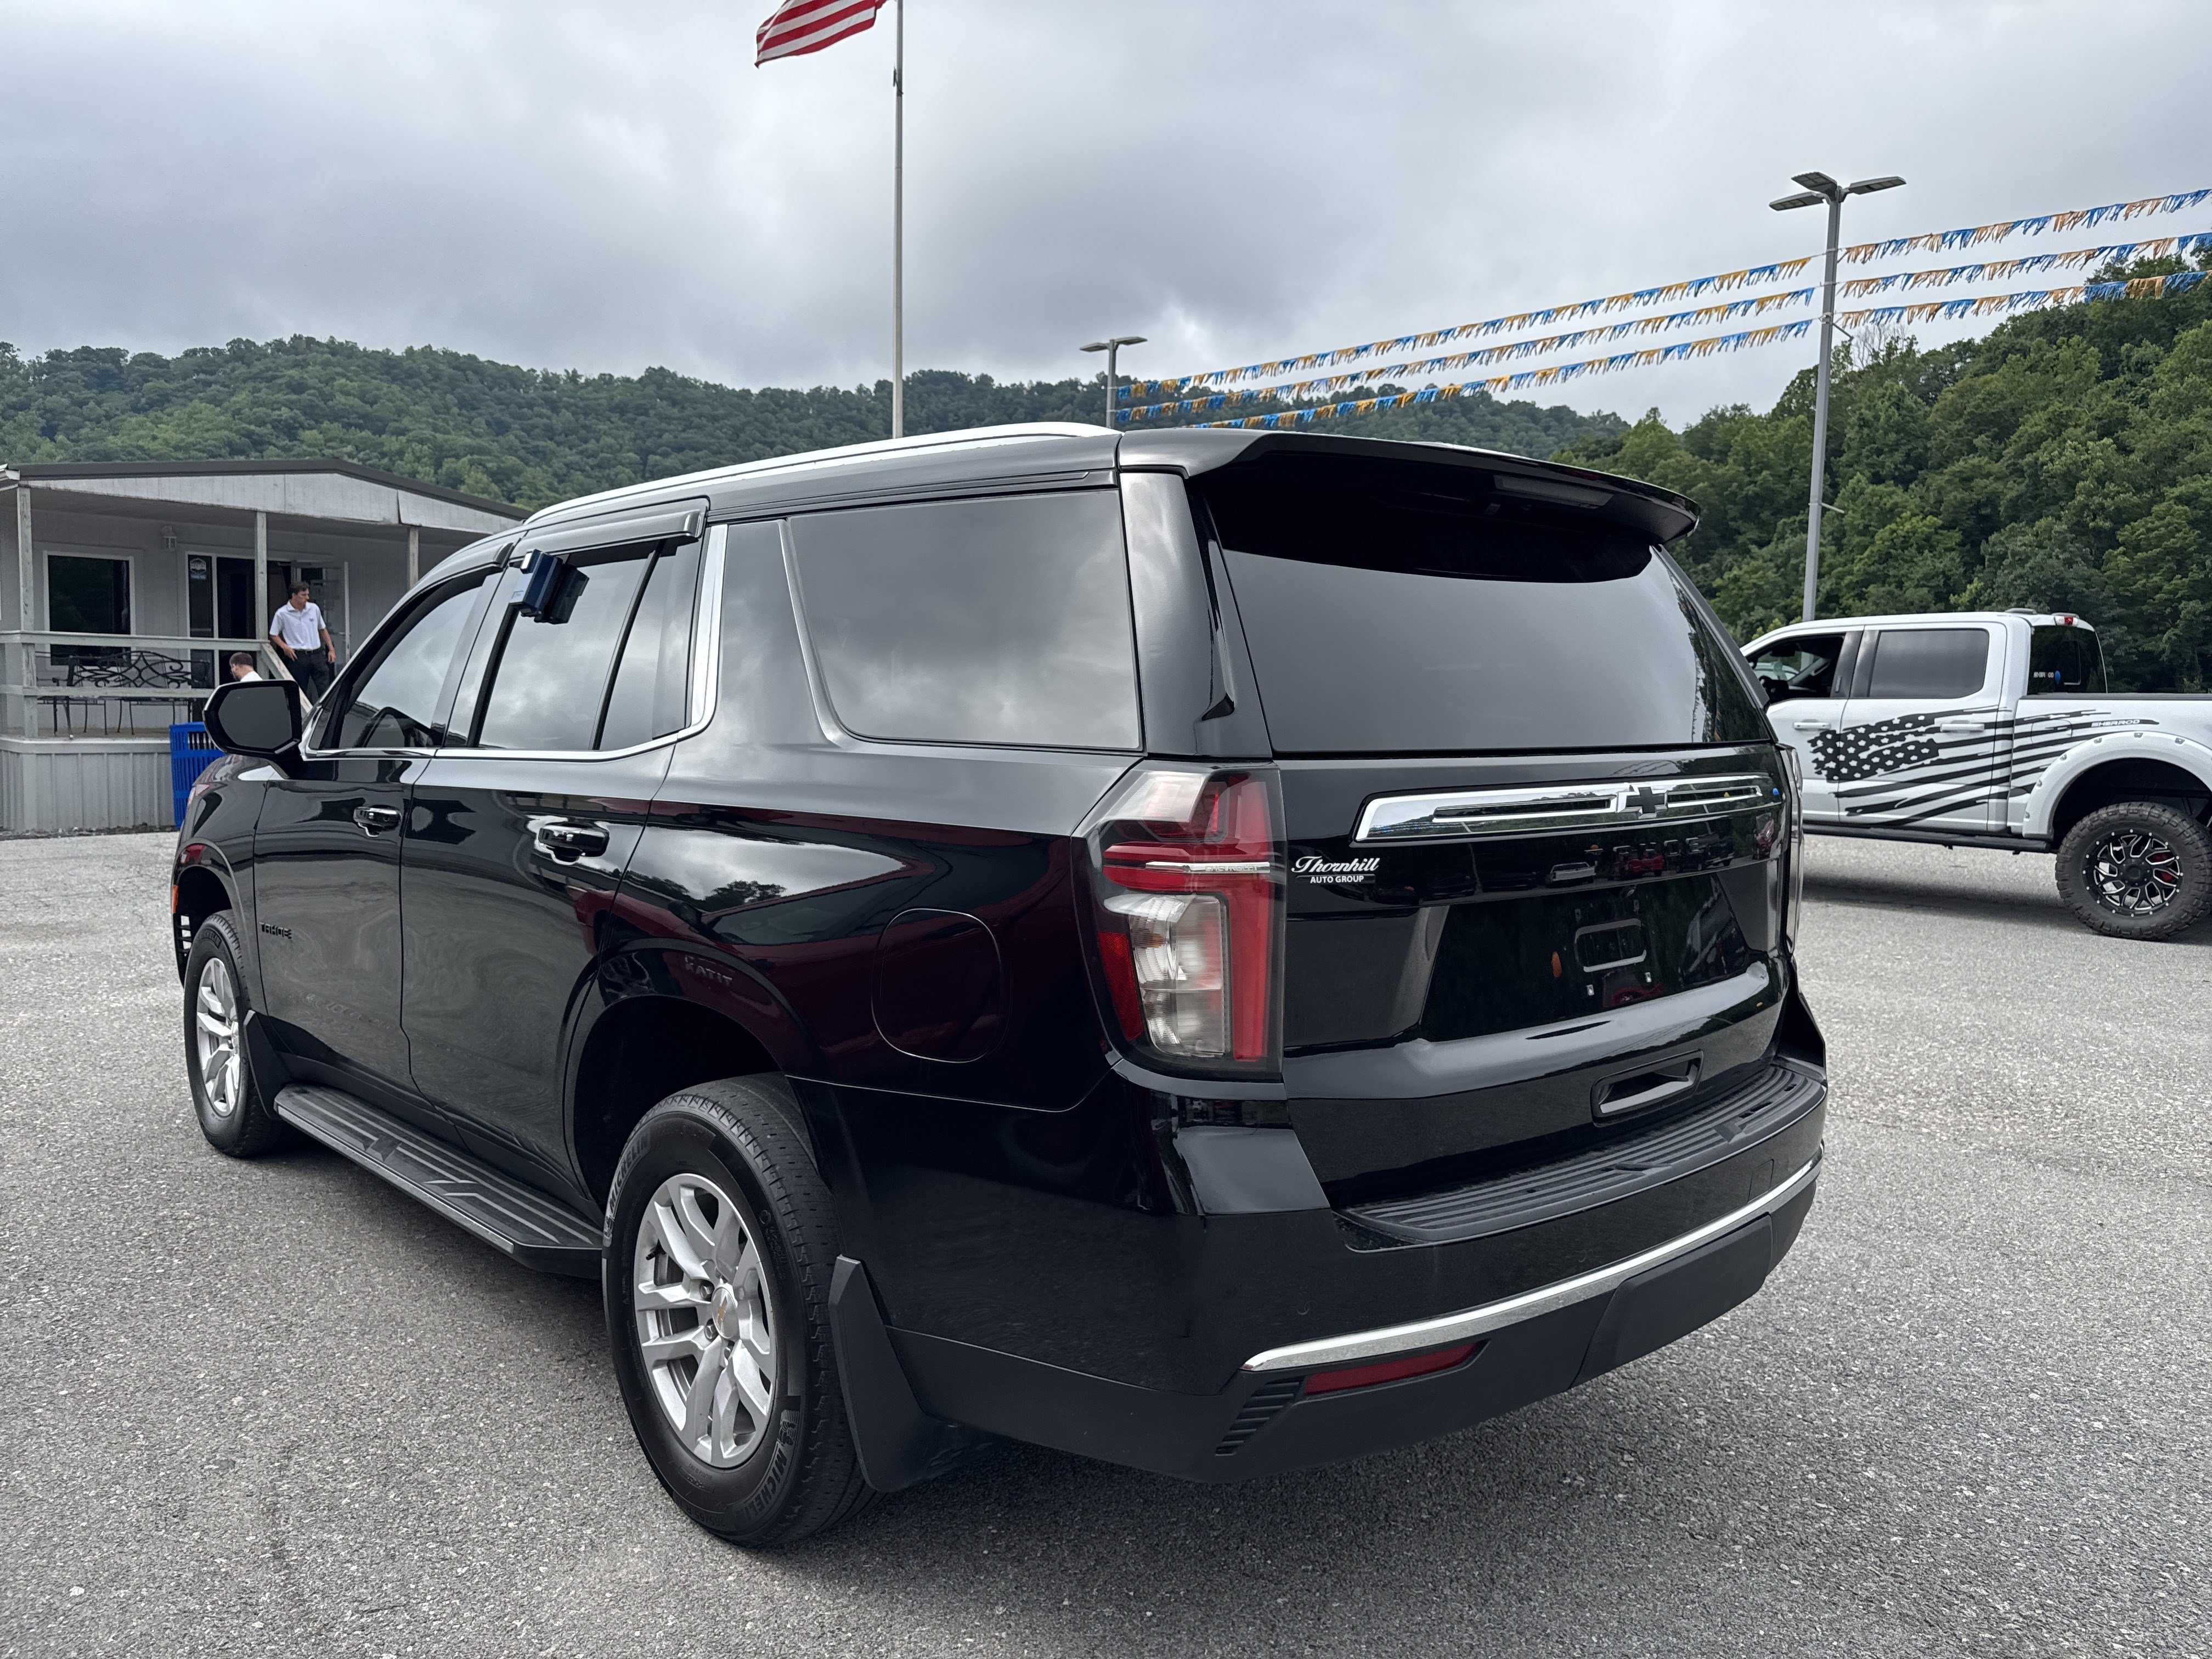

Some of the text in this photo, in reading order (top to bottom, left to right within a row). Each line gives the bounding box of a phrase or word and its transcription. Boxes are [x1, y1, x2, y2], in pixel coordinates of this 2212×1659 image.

[2091, 719, 2141, 727] SHERROD
[1291, 855, 1381, 873] Thornhill
[1335, 875, 1364, 883] GROUP
[258, 922, 292, 939] TAHOE
[609, 1133, 649, 1214] MICHELIN
[733, 1449, 788, 1530] MICHELIN
